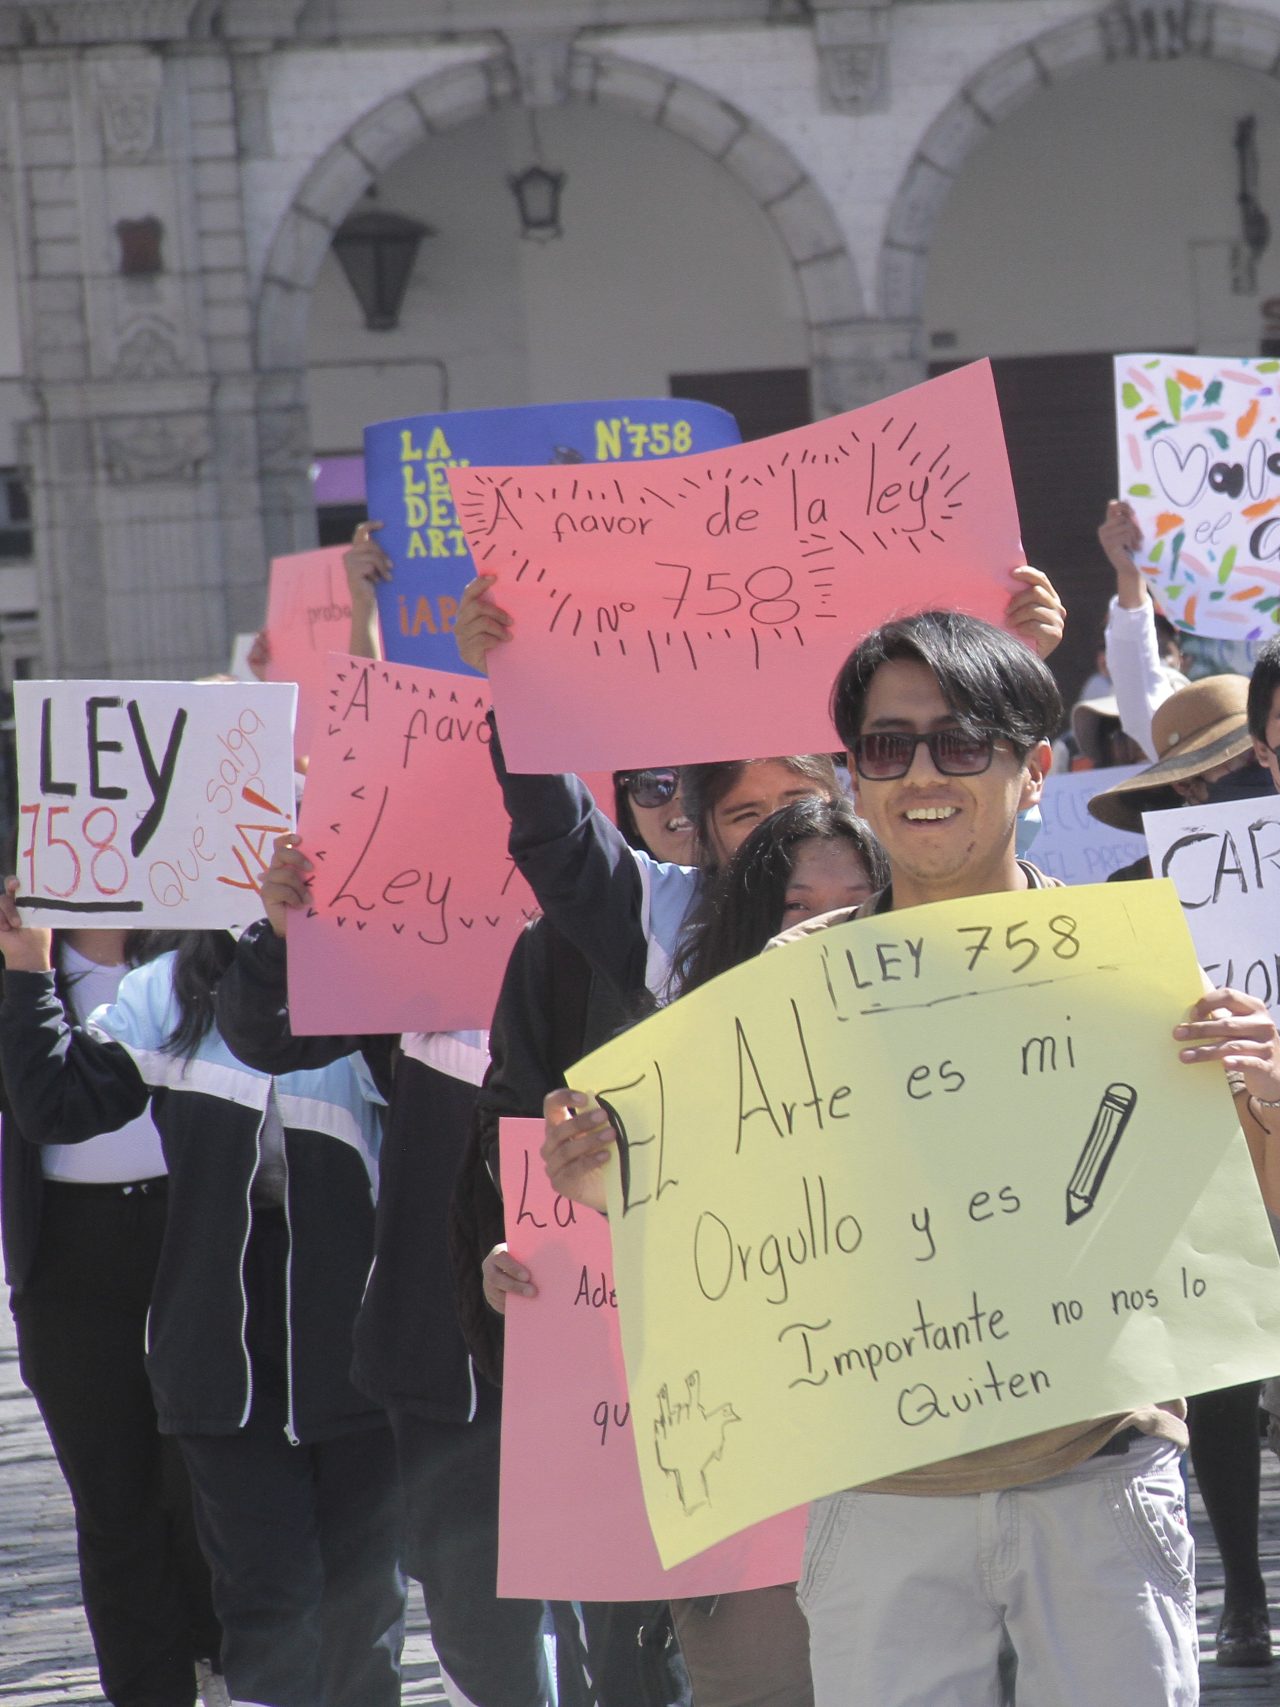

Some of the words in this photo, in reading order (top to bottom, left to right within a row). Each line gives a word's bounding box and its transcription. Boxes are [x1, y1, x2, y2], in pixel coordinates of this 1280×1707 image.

[401, 426, 452, 462] LA
[406, 494, 462, 527] DE
[484, 486, 523, 536] A
[555, 510, 653, 542] favor
[706, 484, 758, 537] de
[790, 469, 828, 531] la
[866, 443, 930, 534] ley
[1194, 510, 1233, 545] el
[655, 561, 801, 625] 758
[343, 668, 368, 722] A
[40, 696, 188, 858] LEY
[20, 803, 129, 899] 758
[149, 826, 216, 907] Que
[329, 786, 451, 944] Ley
[845, 937, 926, 989] LEY
[956, 914, 1081, 973] 758
[735, 998, 853, 1155] Arte
[906, 1060, 965, 1101] es
[1021, 1015, 1076, 1077] mi
[694, 1176, 863, 1304] Orgullo
[911, 1206, 937, 1261] y
[968, 1183, 1021, 1221] es
[778, 1292, 1007, 1389] Importante
[1051, 1299, 1083, 1327] no
[1110, 1286, 1159, 1316] nos
[1180, 1266, 1207, 1301] lo
[896, 1363, 1052, 1426] Quiten
